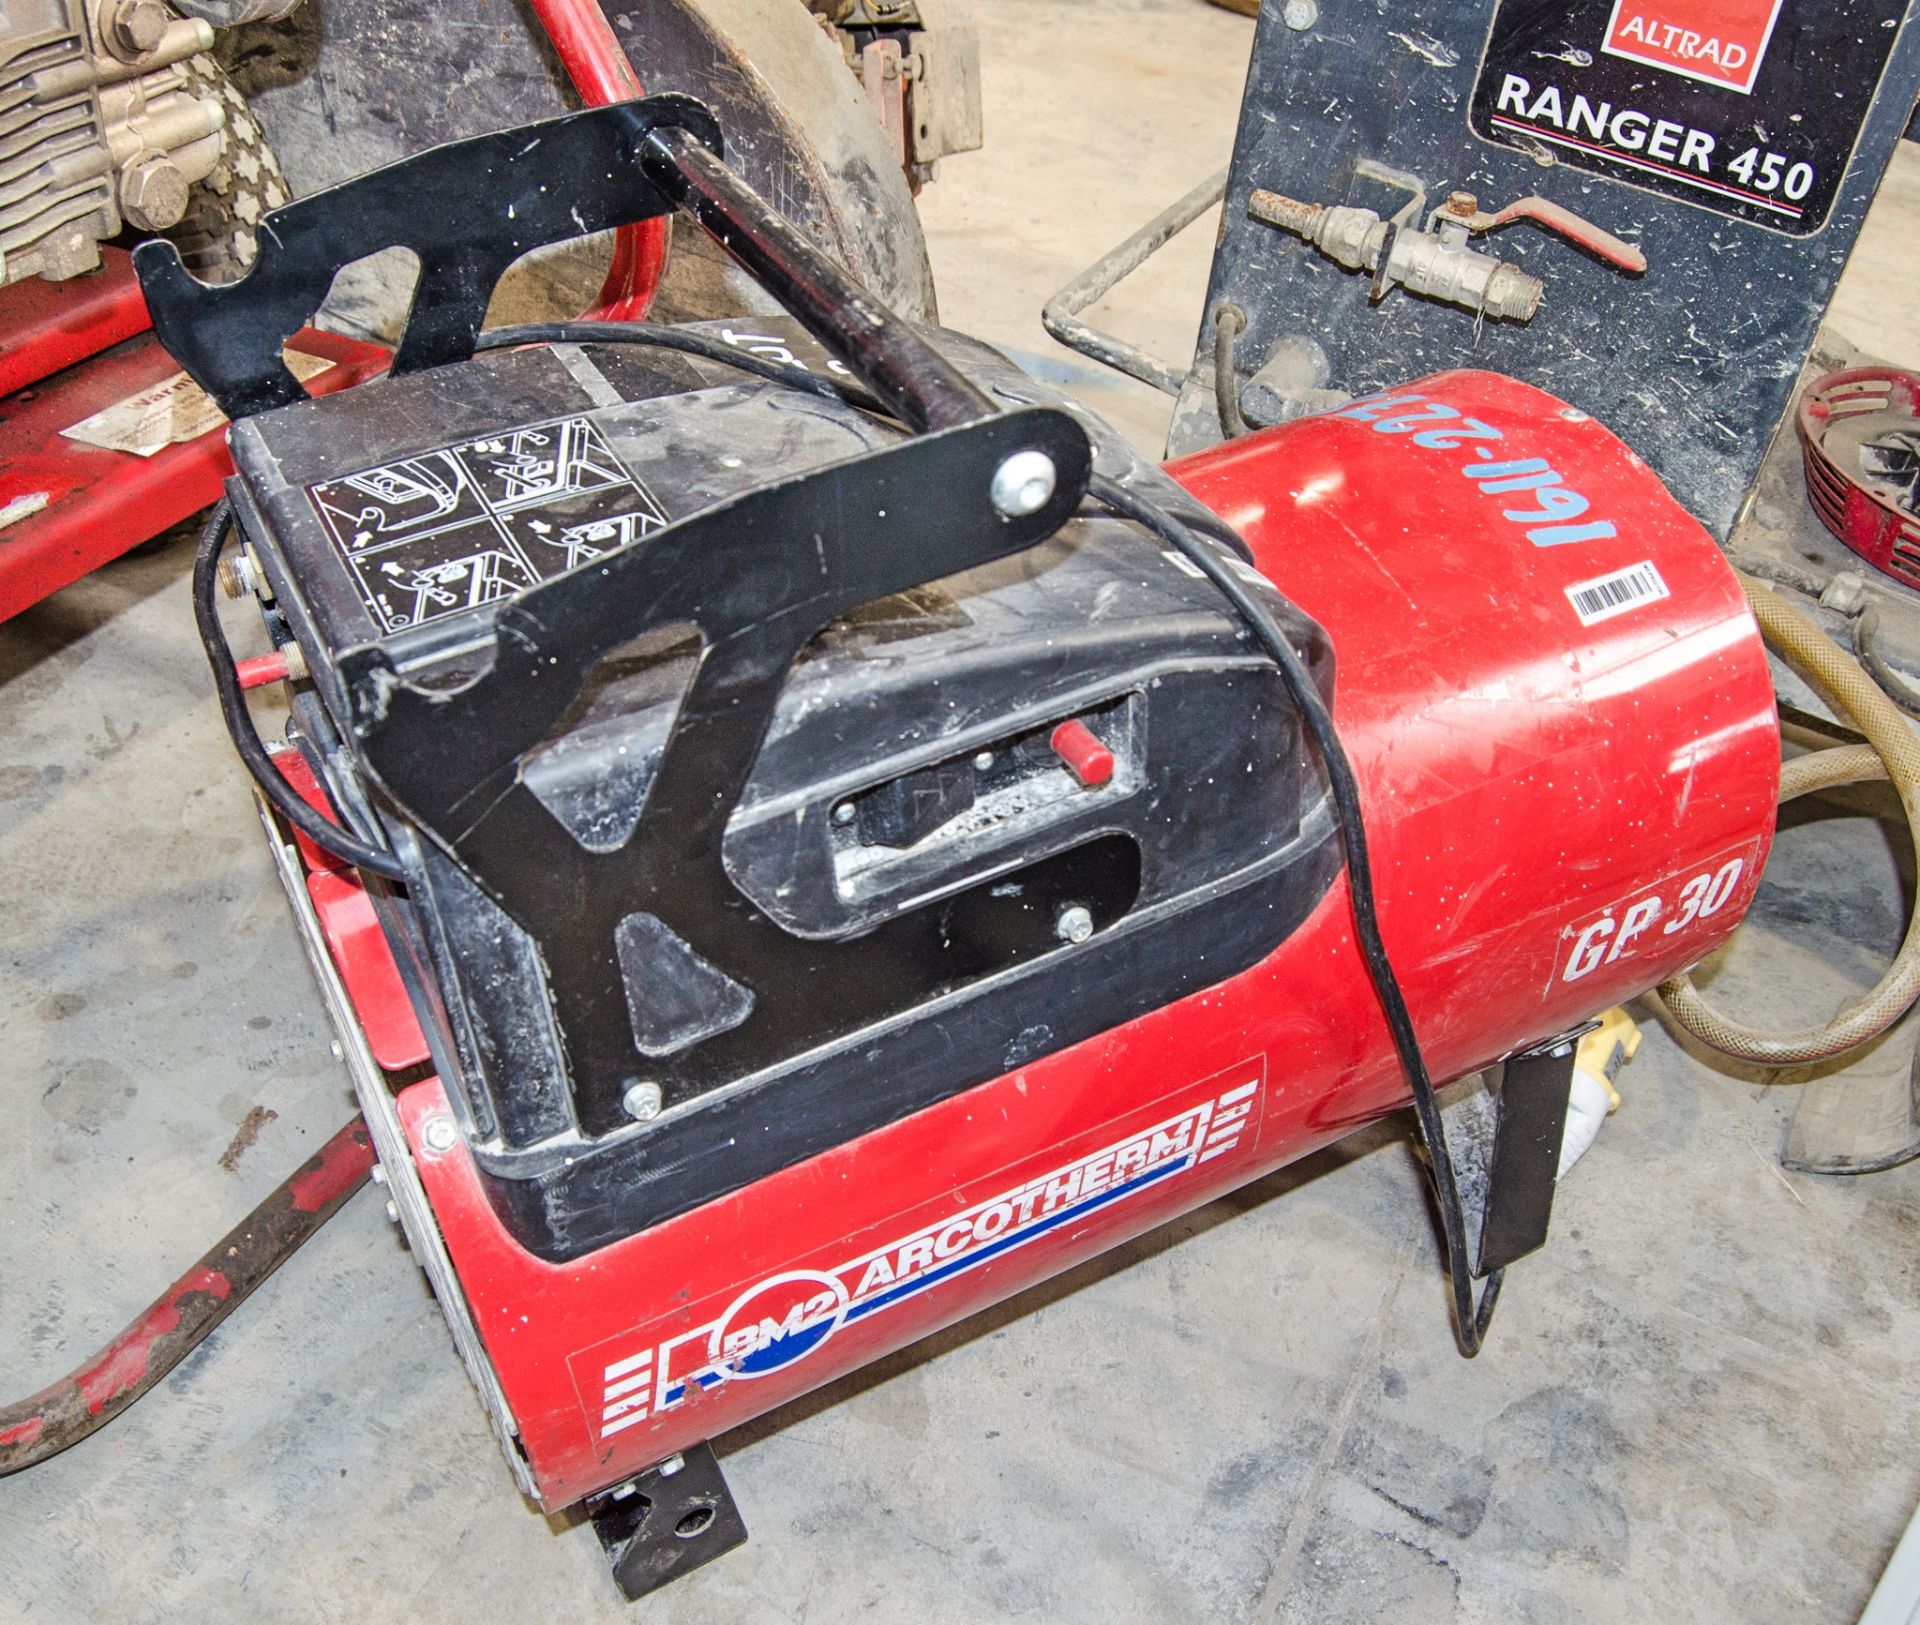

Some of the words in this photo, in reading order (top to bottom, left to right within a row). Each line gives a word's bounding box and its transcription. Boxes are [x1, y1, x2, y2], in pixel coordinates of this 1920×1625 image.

[1619, 15, 1748, 70] ALTRAD
[1497, 73, 1716, 173] RANGER
[1727, 146, 1814, 200] 450
[1562, 896, 1662, 982] GP
[1663, 858, 1744, 934] 30
[852, 1116, 1196, 1298] ARCOTHERM
[723, 1291, 837, 1357] BM2
